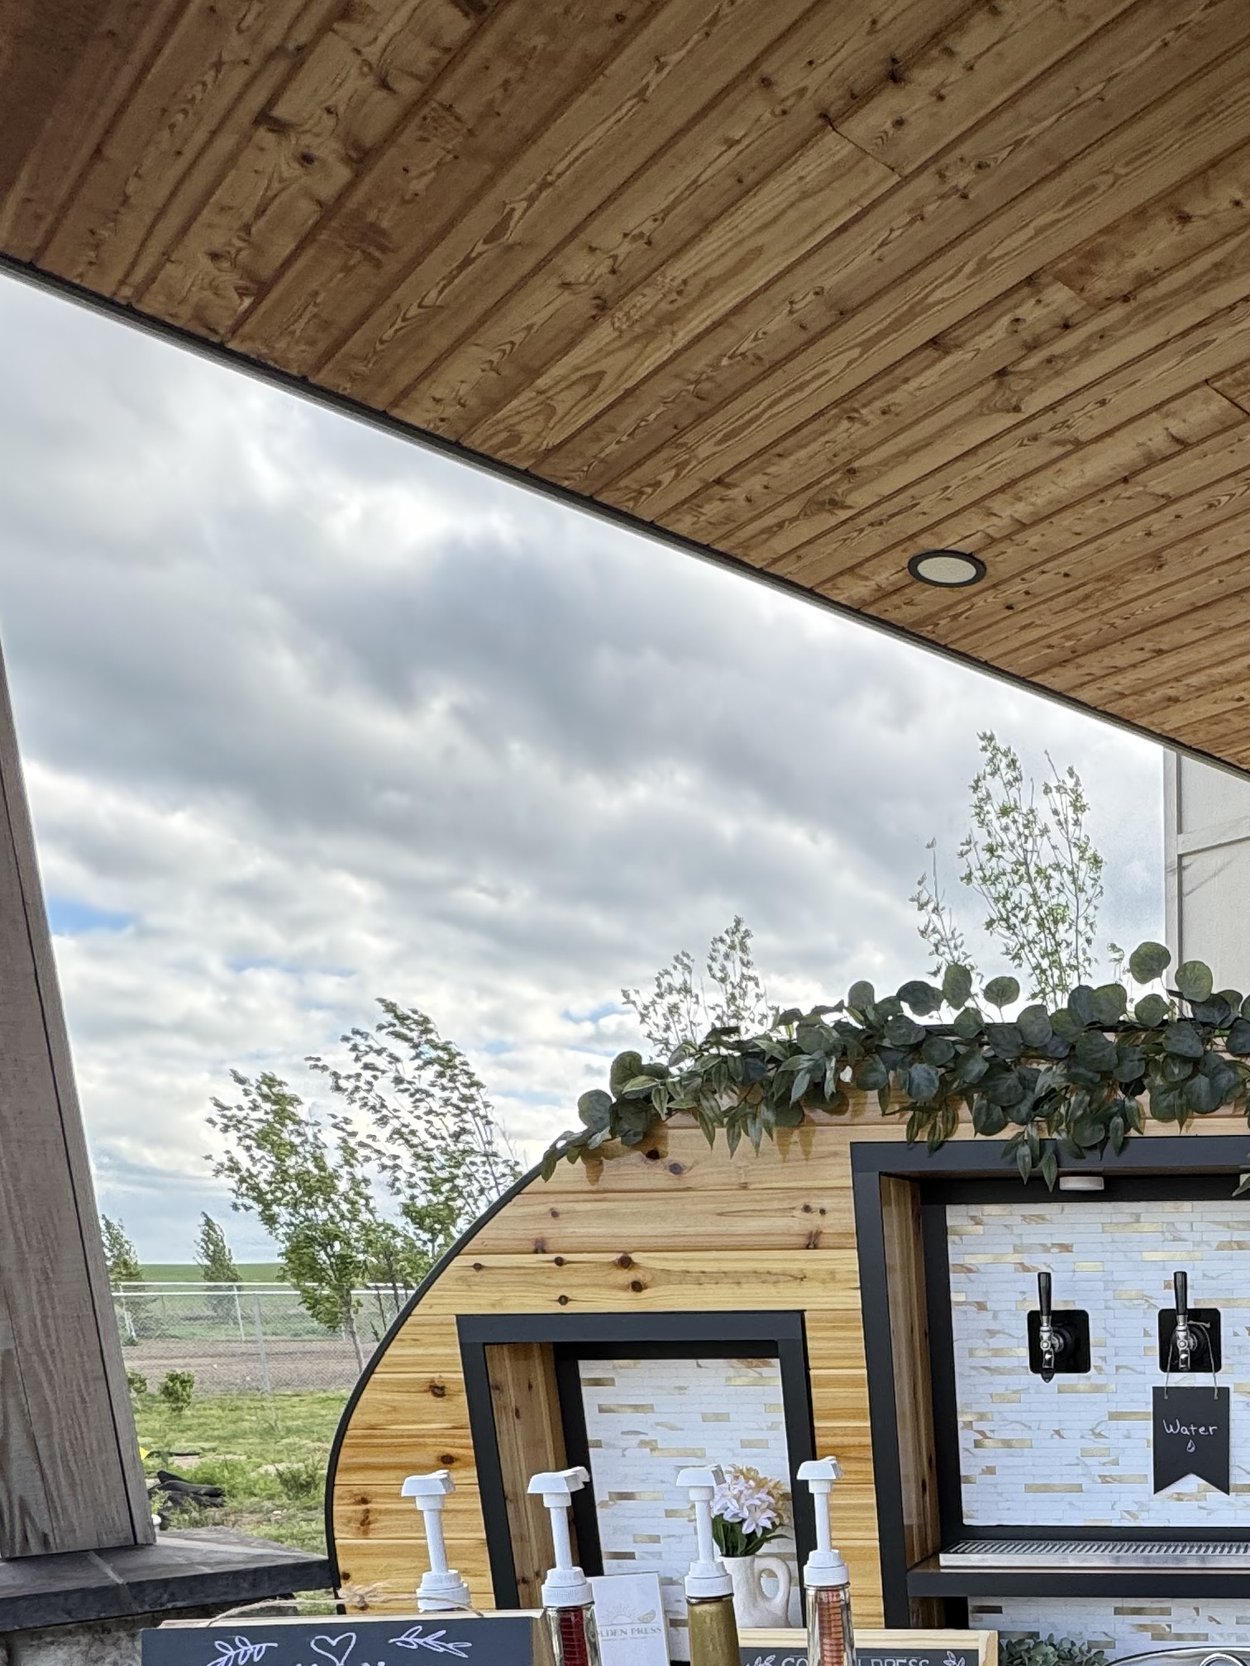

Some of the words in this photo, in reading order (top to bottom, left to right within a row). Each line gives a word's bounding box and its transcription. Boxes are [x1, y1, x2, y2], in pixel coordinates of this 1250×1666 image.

[1162, 1419, 1219, 1437] Water
[600, 1629, 628, 1638] LDEN
[631, 1626, 662, 1636] PRESS
